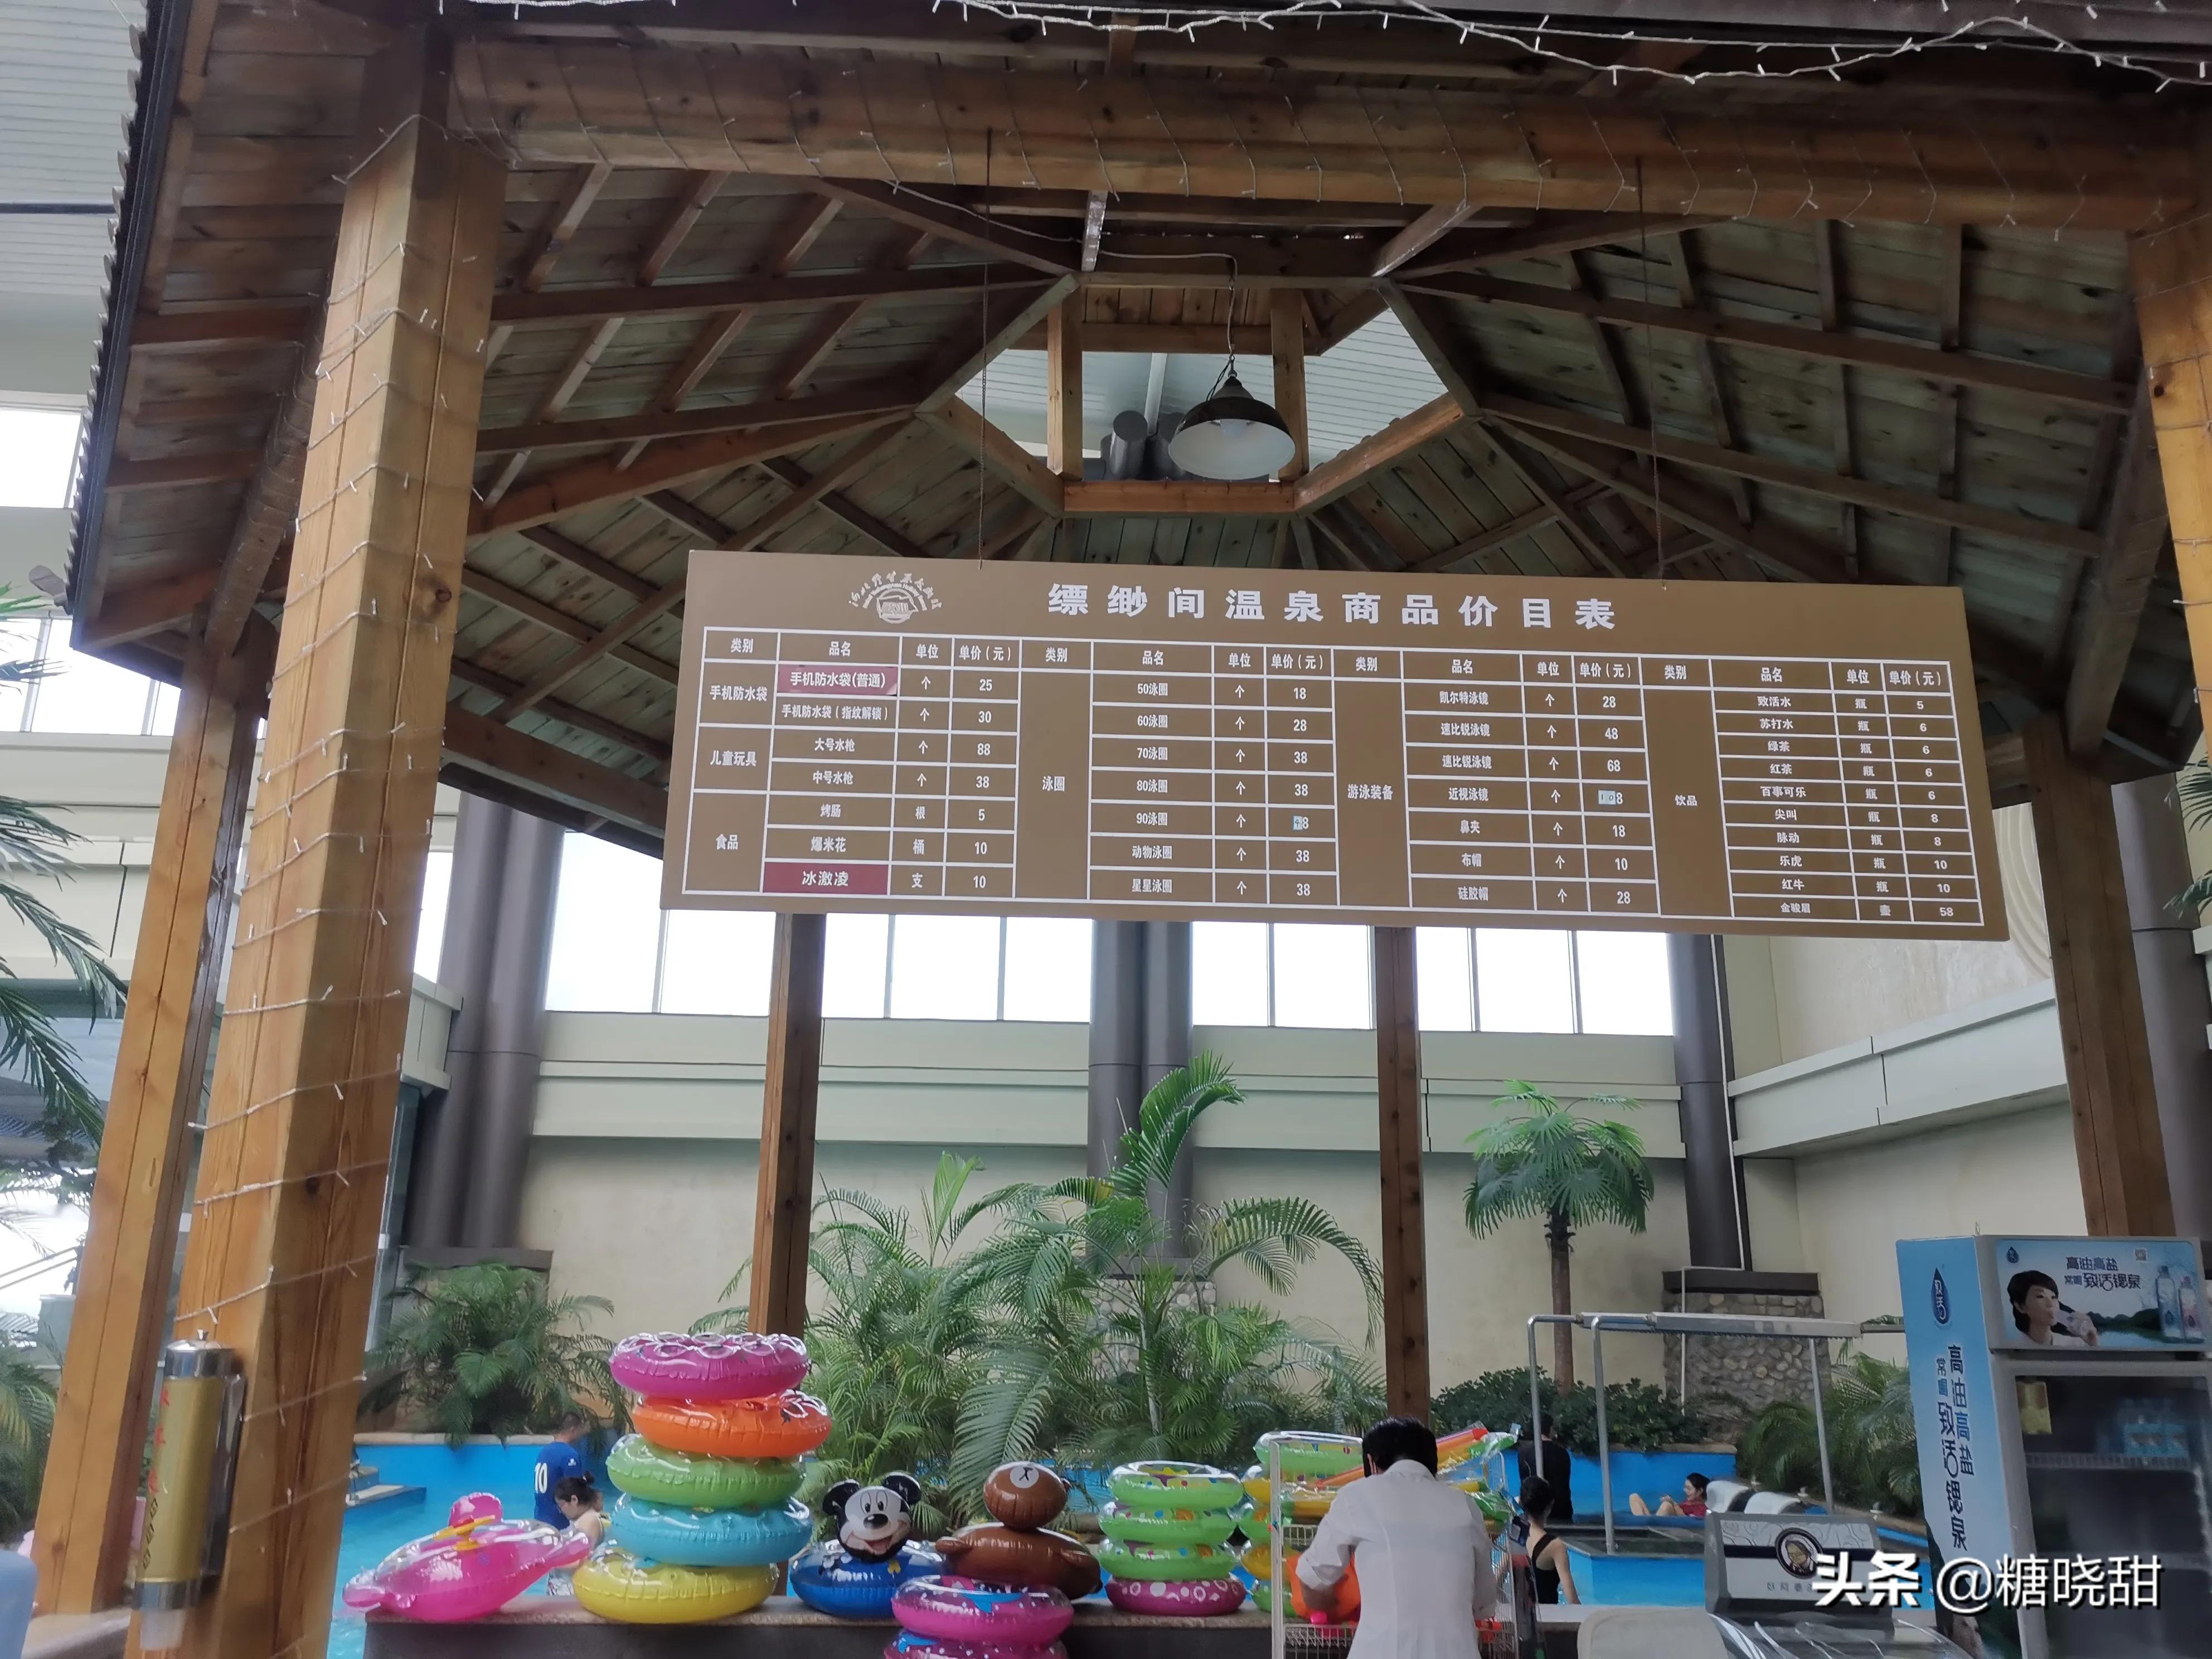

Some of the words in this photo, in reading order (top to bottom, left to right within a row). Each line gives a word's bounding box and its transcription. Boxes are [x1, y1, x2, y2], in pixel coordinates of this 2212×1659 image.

[1047, 583, 1616, 630] 缥缈间温泉商品价目表
[730, 637, 754, 653] 类别
[829, 641, 851, 657] 品名
[915, 643, 939, 659] 单位
[1045, 647, 1068, 663] 类别
[1142, 649, 1163, 666] 品名
[1228, 652, 1251, 668] 单位
[1355, 656, 1377, 672] 类别
[1452, 659, 1473, 674] 品名
[1537, 661, 1560, 677] 单位
[789, 671, 885, 689] 手机防水袋(普通)
[921, 676, 931, 690] 个
[979, 678, 993, 691] 25
[1664, 664, 1687, 680] 类别
[1760, 666, 1783, 682] 品名
[1846, 668, 1870, 685] 单位
[709, 685, 768, 702] 手机防水袋
[1137, 682, 1168, 696] 50泳圈
[1235, 685, 1245, 698] 个
[1293, 687, 1307, 700] 18
[1439, 690, 1489, 705] 凯尔特泳镜
[1545, 693, 1555, 707] 个
[1602, 695, 1617, 709] 28
[1757, 695, 1792, 707] 致活水
[1855, 698, 1867, 710] 瓶
[1916, 700, 1924, 710] 5
[919, 707, 930, 722] 个
[978, 710, 992, 724] 30
[1137, 714, 1168, 729] 60泳圈
[1235, 716, 1245, 731] 个
[1293, 719, 1307, 732] 28
[1759, 717, 1794, 730] 苏打水
[1857, 720, 1870, 732] 瓶
[1919, 722, 1927, 732] 6
[1440, 722, 1491, 737] 速比锐泳镜
[1546, 725, 1557, 739] 个
[1604, 727, 1618, 740] 48
[814, 737, 855, 752] 大号水枪
[918, 740, 928, 754] 个
[977, 743, 991, 756] 88
[1137, 746, 1168, 761] 70泳圈
[1235, 749, 1245, 763] 个
[1294, 751, 1308, 764] 38
[1767, 740, 1790, 752] 绿茶
[1860, 743, 1873, 754] 瓶
[1922, 745, 1930, 755] 6
[710, 750, 757, 767] 儿童玩具
[1442, 754, 1492, 769] 速比锐泳镜
[1549, 756, 1559, 771] 个
[1607, 759, 1621, 772] 68
[812, 770, 853, 785] 中号水枪
[916, 773, 927, 787] 个
[976, 775, 989, 789] 38
[1769, 763, 1793, 775] 红茶
[1862, 765, 1875, 777] 瓶
[1925, 768, 1933, 778] 6
[1042, 775, 1065, 793] 泳圈
[1136, 779, 1168, 793] 80泳圈
[1235, 780, 1246, 795] 个
[1294, 783, 1308, 797] 38
[1347, 783, 1394, 801] 游泳装备
[1760, 785, 1807, 798] 百事可乐
[1865, 788, 1878, 800] 瓶
[1928, 790, 1936, 801] 6
[1448, 787, 1489, 802] 近视泳镜
[1550, 789, 1561, 803] 个
[1675, 794, 1697, 807] 饮品
[820, 803, 841, 818] 烤肠
[915, 806, 925, 820] 根
[978, 808, 986, 821] 5
[1136, 812, 1168, 826] 90泳圈
[1236, 813, 1246, 828] 个
[1774, 808, 1797, 821] 尖叫
[1867, 811, 1880, 823] 瓶
[1930, 813, 1939, 823] 8
[1460, 819, 1481, 834] 鼻夹
[1553, 821, 1563, 837] 个
[1612, 824, 1626, 838] 18
[716, 833, 739, 850] 食品
[811, 836, 846, 853] 爆米花
[913, 838, 925, 855] 桶
[974, 841, 987, 855] 10
[1777, 832, 1800, 843] 脉动
[1870, 834, 1884, 846] 瓶
[1934, 836, 1942, 847] 8
[1132, 845, 1172, 860] 动物泳圈
[1236, 847, 1246, 861] 个
[1296, 849, 1310, 863] 38
[1461, 852, 1482, 867] 布帽
[1555, 855, 1565, 870] 个
[1614, 857, 1628, 871] 10
[1779, 855, 1803, 867] 乐虎
[1873, 857, 1886, 870] 瓶
[1934, 860, 1948, 870] 10
[802, 870, 848, 887] 冰激凌
[911, 872, 923, 888] 支
[973, 875, 986, 889] 10
[1132, 878, 1172, 894] 星星泳圈
[1236, 880, 1247, 895] 个
[1297, 882, 1311, 896] 38
[1781, 878, 1805, 891] 红牛
[1876, 881, 1889, 892] 瓶
[1936, 883, 1951, 893] 10
[1458, 886, 1488, 901] 硅胶帽
[1557, 888, 1568, 903] 个
[1617, 891, 1631, 905] 28
[1780, 902, 1811, 914] 金骏眉
[1939, 906, 1954, 917] 58
[1948, 1345, 1975, 1476] 高油高盐
[534, 1462, 548, 1495] 10
